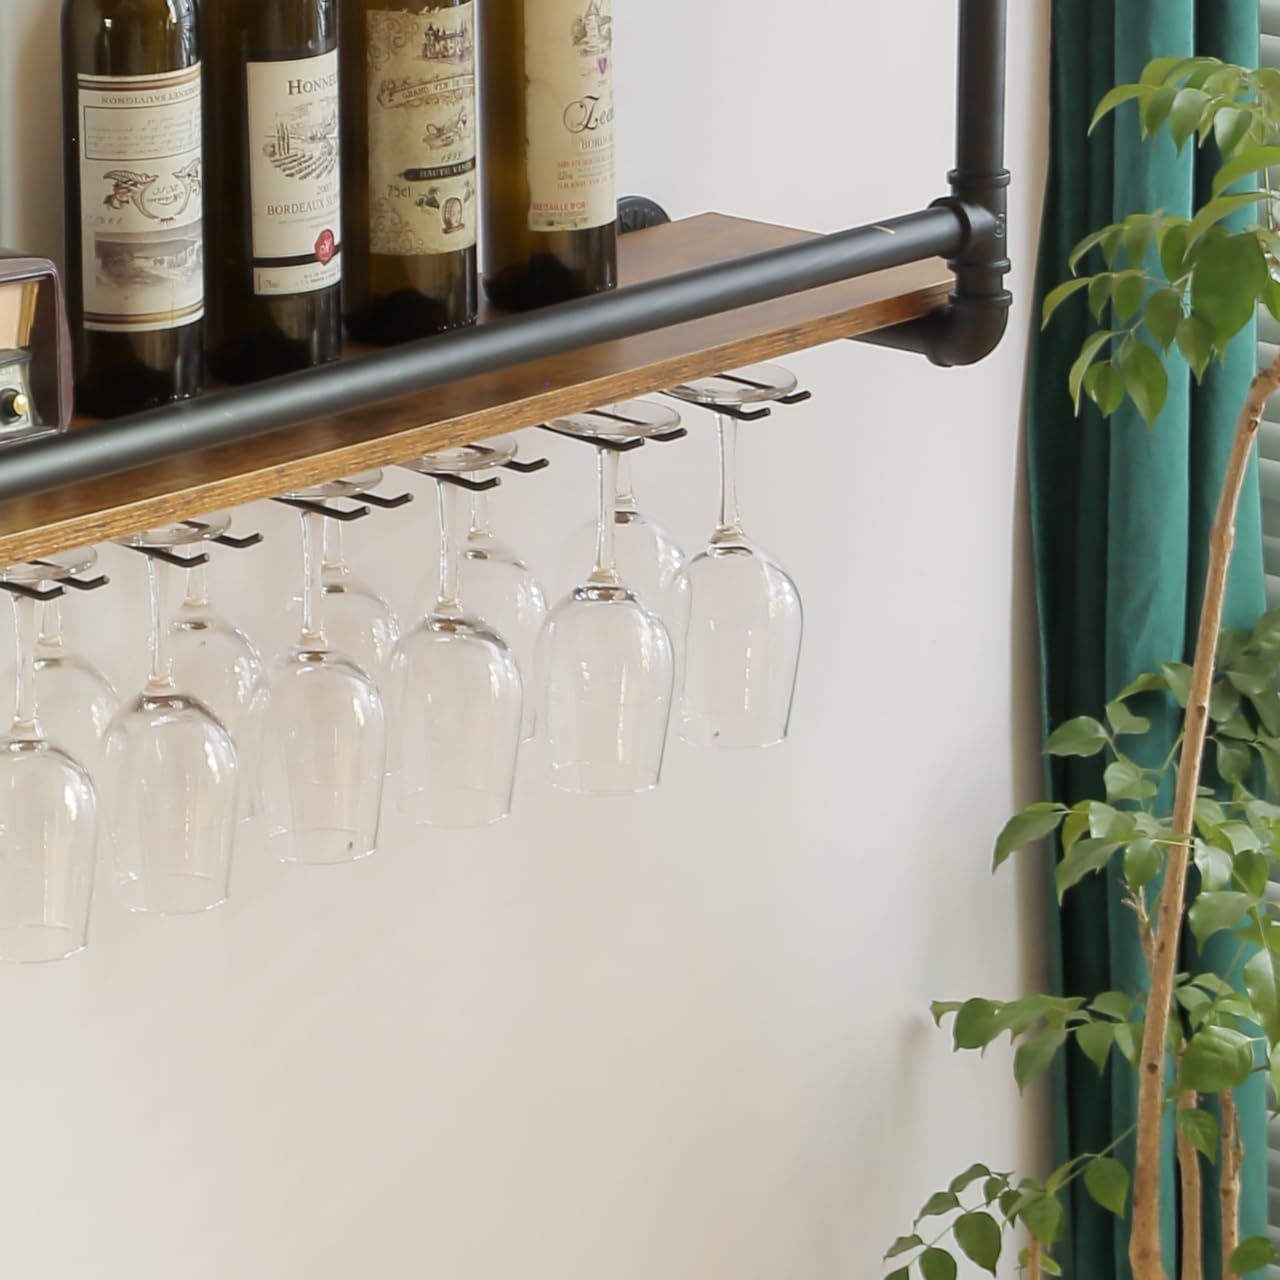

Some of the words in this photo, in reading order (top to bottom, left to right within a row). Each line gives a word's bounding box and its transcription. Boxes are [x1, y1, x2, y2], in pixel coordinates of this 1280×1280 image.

[100, 93, 166, 105] SAUVIGNON
[386, 183, 411, 198] 75cl
[267, 199, 325, 216] BORDEAUX
